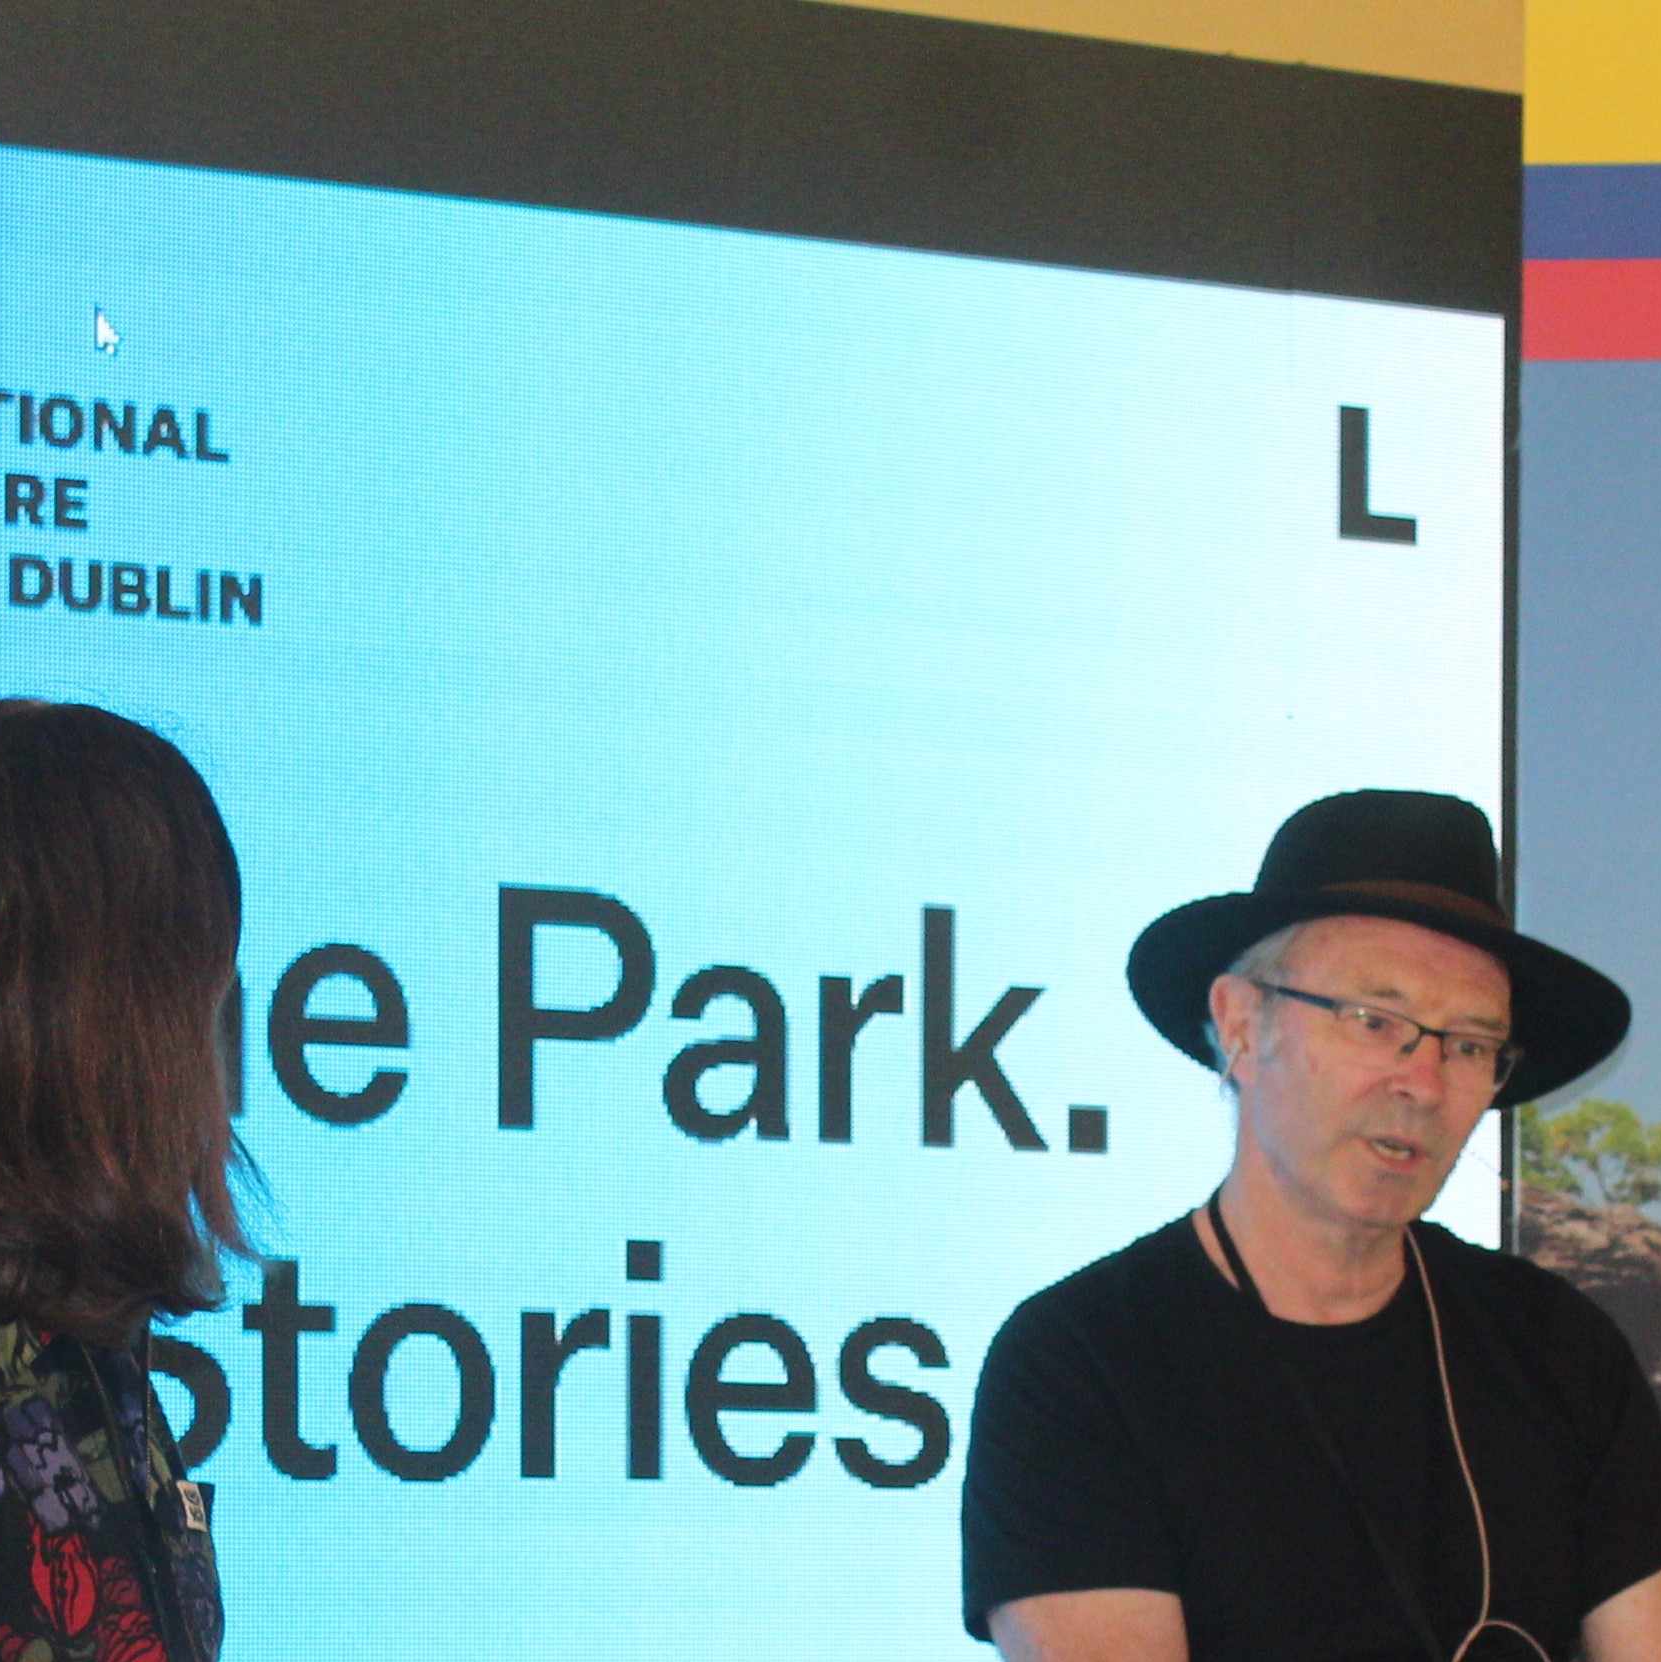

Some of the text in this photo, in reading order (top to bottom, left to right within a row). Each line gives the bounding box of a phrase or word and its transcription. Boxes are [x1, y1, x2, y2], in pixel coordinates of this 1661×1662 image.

[1340, 405, 1417, 545] L
[9, 556, 263, 626] DUBLIN
[498, 882, 1108, 1154] Park.
